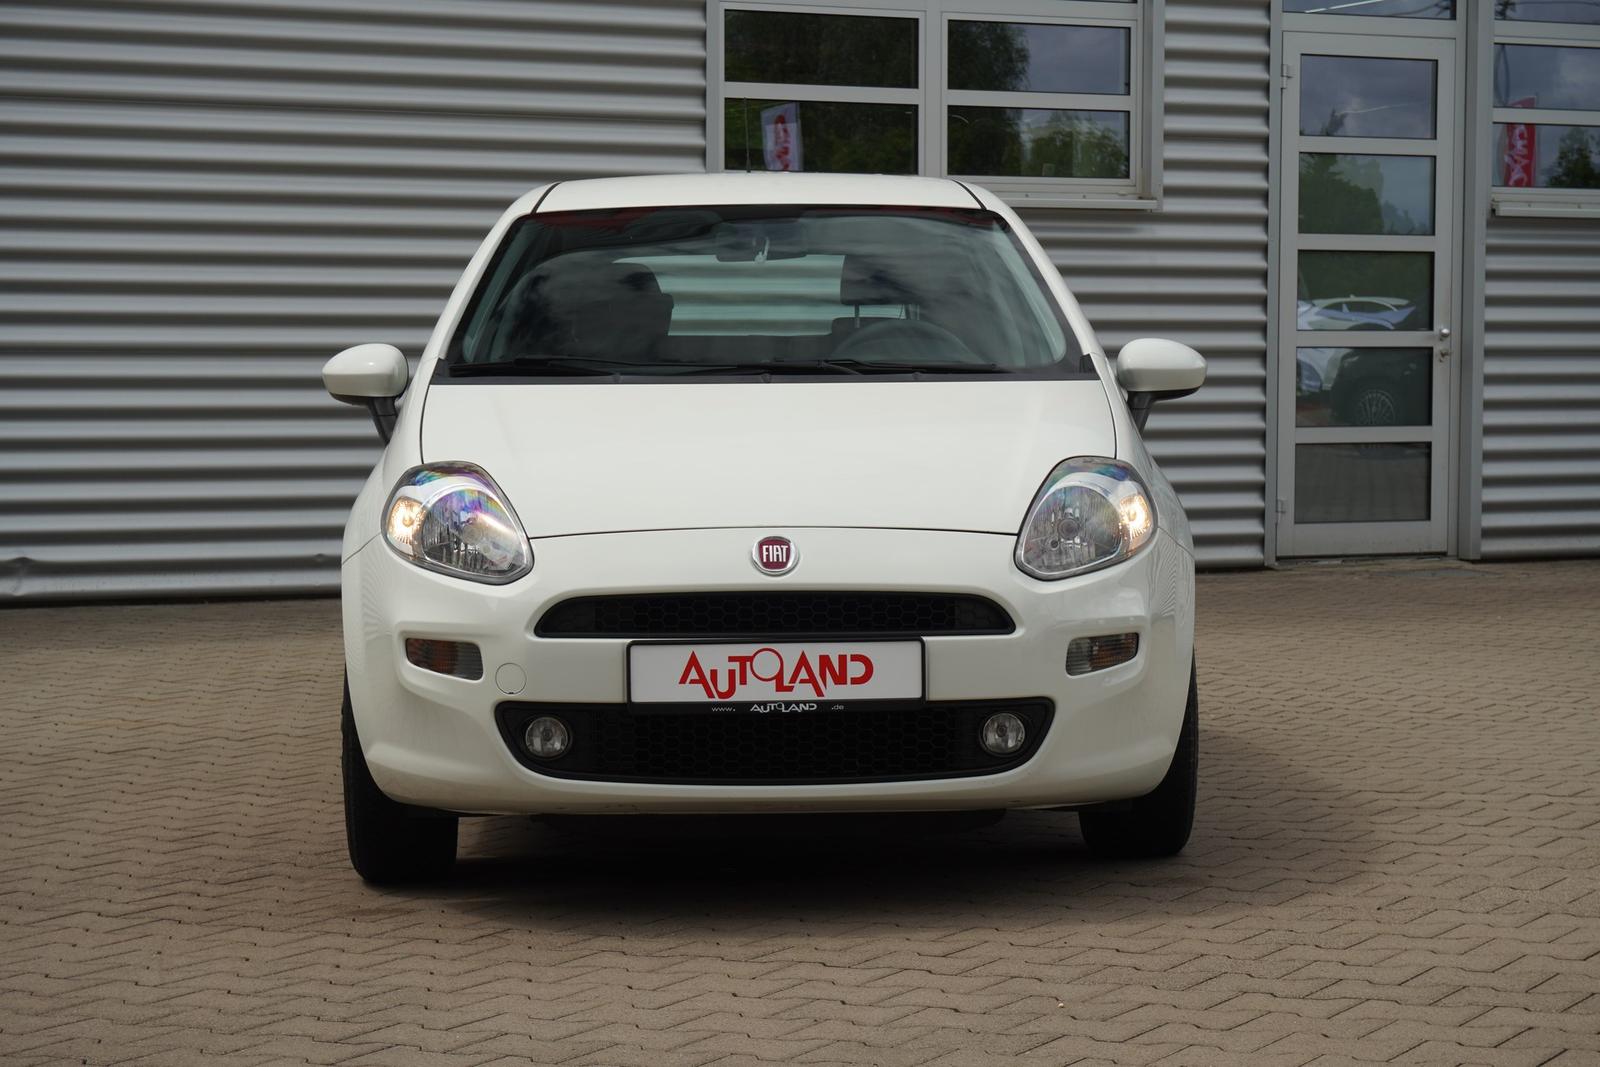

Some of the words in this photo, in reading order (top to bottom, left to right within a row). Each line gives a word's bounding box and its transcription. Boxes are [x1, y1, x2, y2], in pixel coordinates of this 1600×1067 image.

[762, 545, 788, 562] FIAT
[678, 648, 874, 699] AUTOLAND
[750, 702, 818, 713] AUTOLAND
